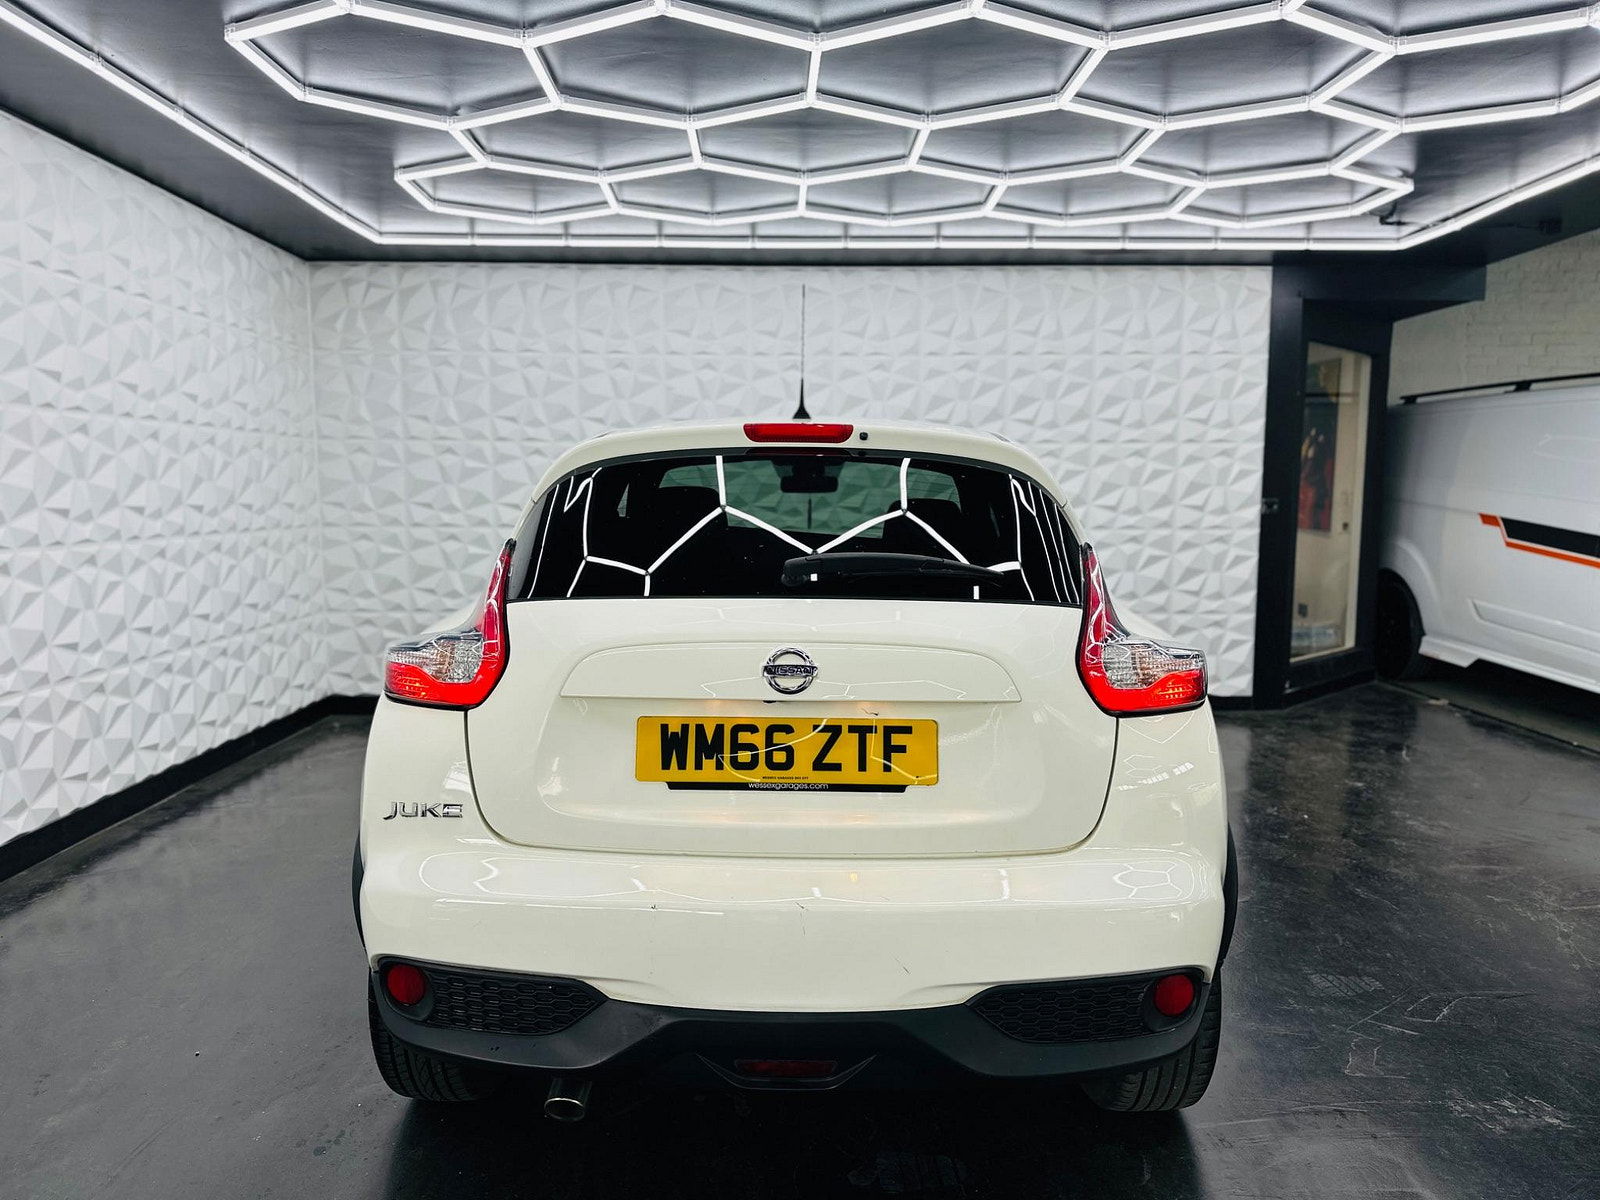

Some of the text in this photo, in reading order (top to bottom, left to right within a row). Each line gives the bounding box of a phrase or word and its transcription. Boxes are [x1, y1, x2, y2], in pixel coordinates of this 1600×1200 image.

[765, 666, 814, 676] NISSAN
[660, 723, 913, 773] WM66 ZTF
[748, 782, 829, 790] wessexgarages.com
[383, 802, 463, 820] JUKE
